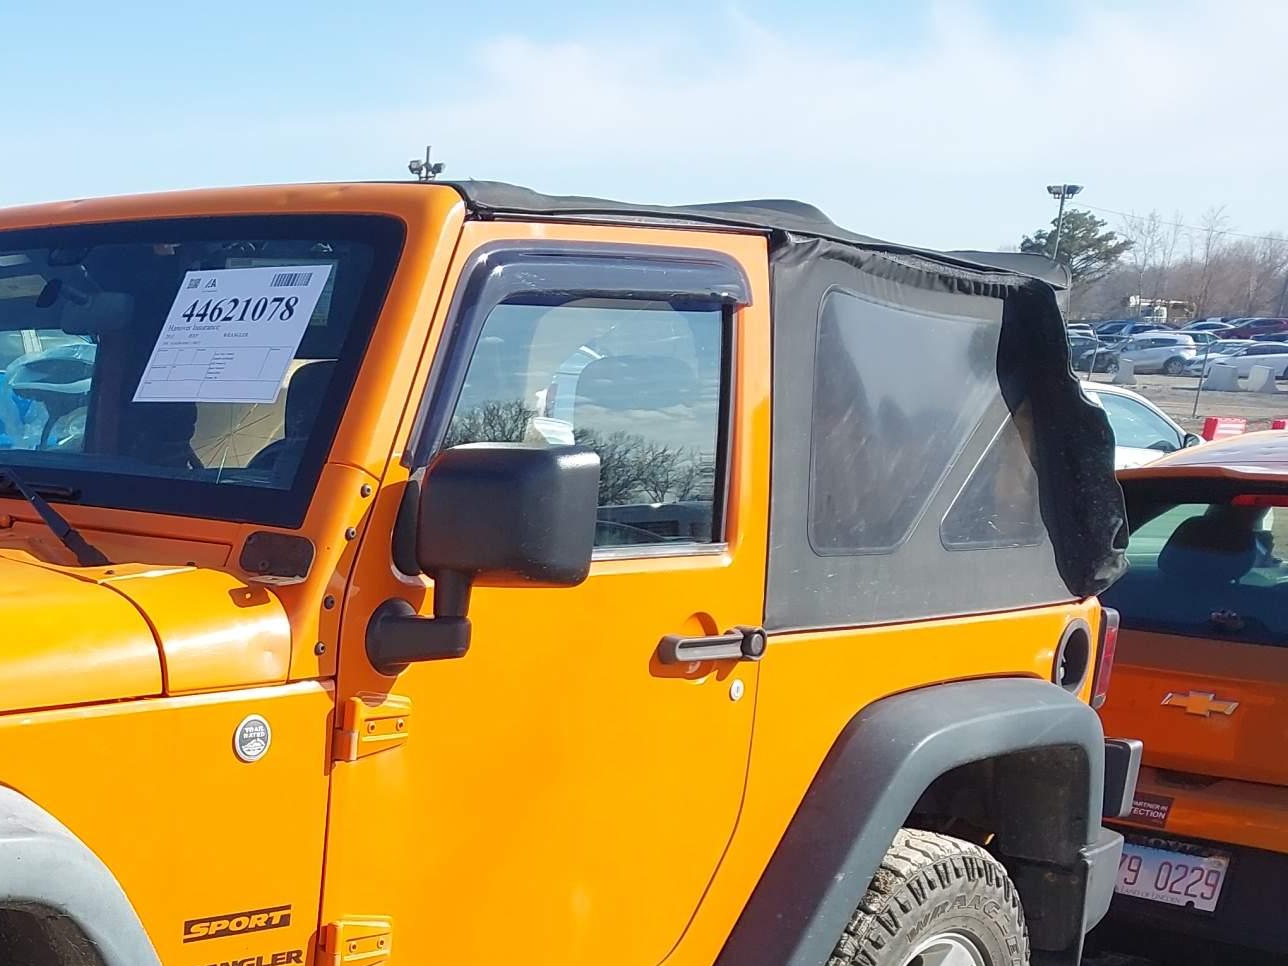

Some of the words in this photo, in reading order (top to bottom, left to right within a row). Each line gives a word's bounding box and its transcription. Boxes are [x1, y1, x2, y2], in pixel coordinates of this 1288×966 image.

[182, 296, 299, 323] 44621078
[1154, 861, 1221, 900] 0229
[188, 908, 290, 938] SPORT
